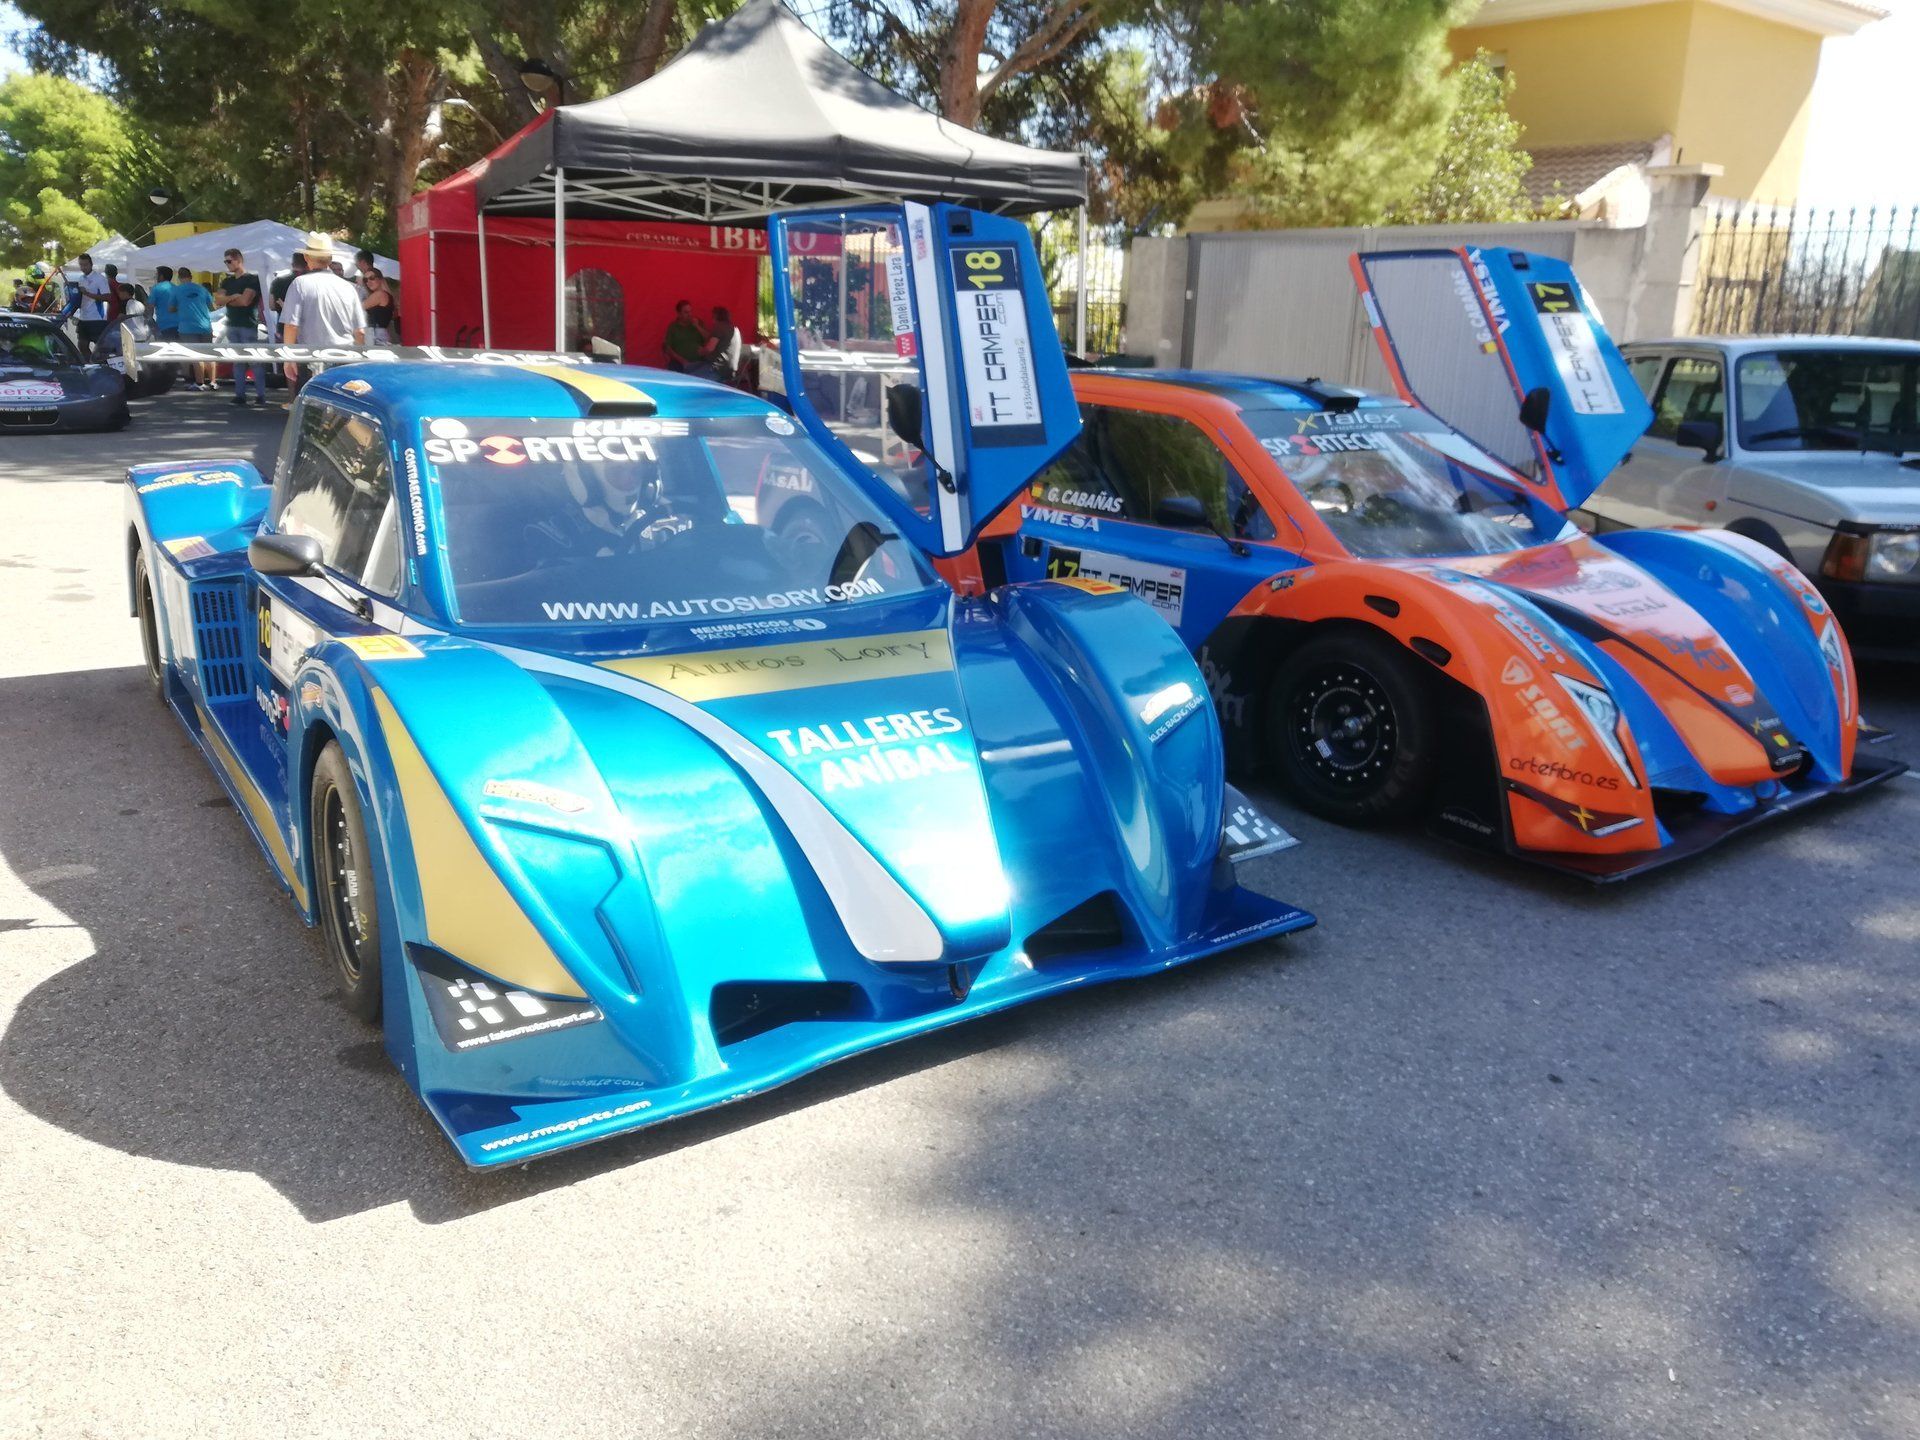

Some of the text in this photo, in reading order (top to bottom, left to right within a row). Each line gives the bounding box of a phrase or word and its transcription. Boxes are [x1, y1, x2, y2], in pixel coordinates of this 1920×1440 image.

[709, 226, 817, 252] IBEO
[892, 256, 904, 277] Lara
[965, 251, 1005, 290] 18
[1469, 248, 1511, 334] VIMESA
[1536, 283, 1571, 313] 17
[897, 302, 911, 332] Daniel
[142, 341, 400, 363] Autos
[975, 293, 1008, 382] CAMPER
[1552, 316, 1603, 413] TT CAMPER
[0, 386, 64, 398] erezo
[988, 391, 1014, 423] TT
[572, 420, 690, 437] KUDE
[1047, 486, 1124, 513] G. CABAÑAS
[1020, 503, 1100, 533] VIMESA
[1047, 558, 1079, 579] 17
[541, 577, 885, 621] WWW.AUTOSLORY.COM
[258, 605, 272, 649] 18
[669, 642, 932, 680] Autos Lory
[1165, 708, 1189, 728] RACING
[1186, 694, 1205, 711] TEAM
[766, 707, 963, 759] TALLERES
[819, 742, 970, 793] ANÍBAL
[479, 1099, 652, 1152] www.rmoparts.com
